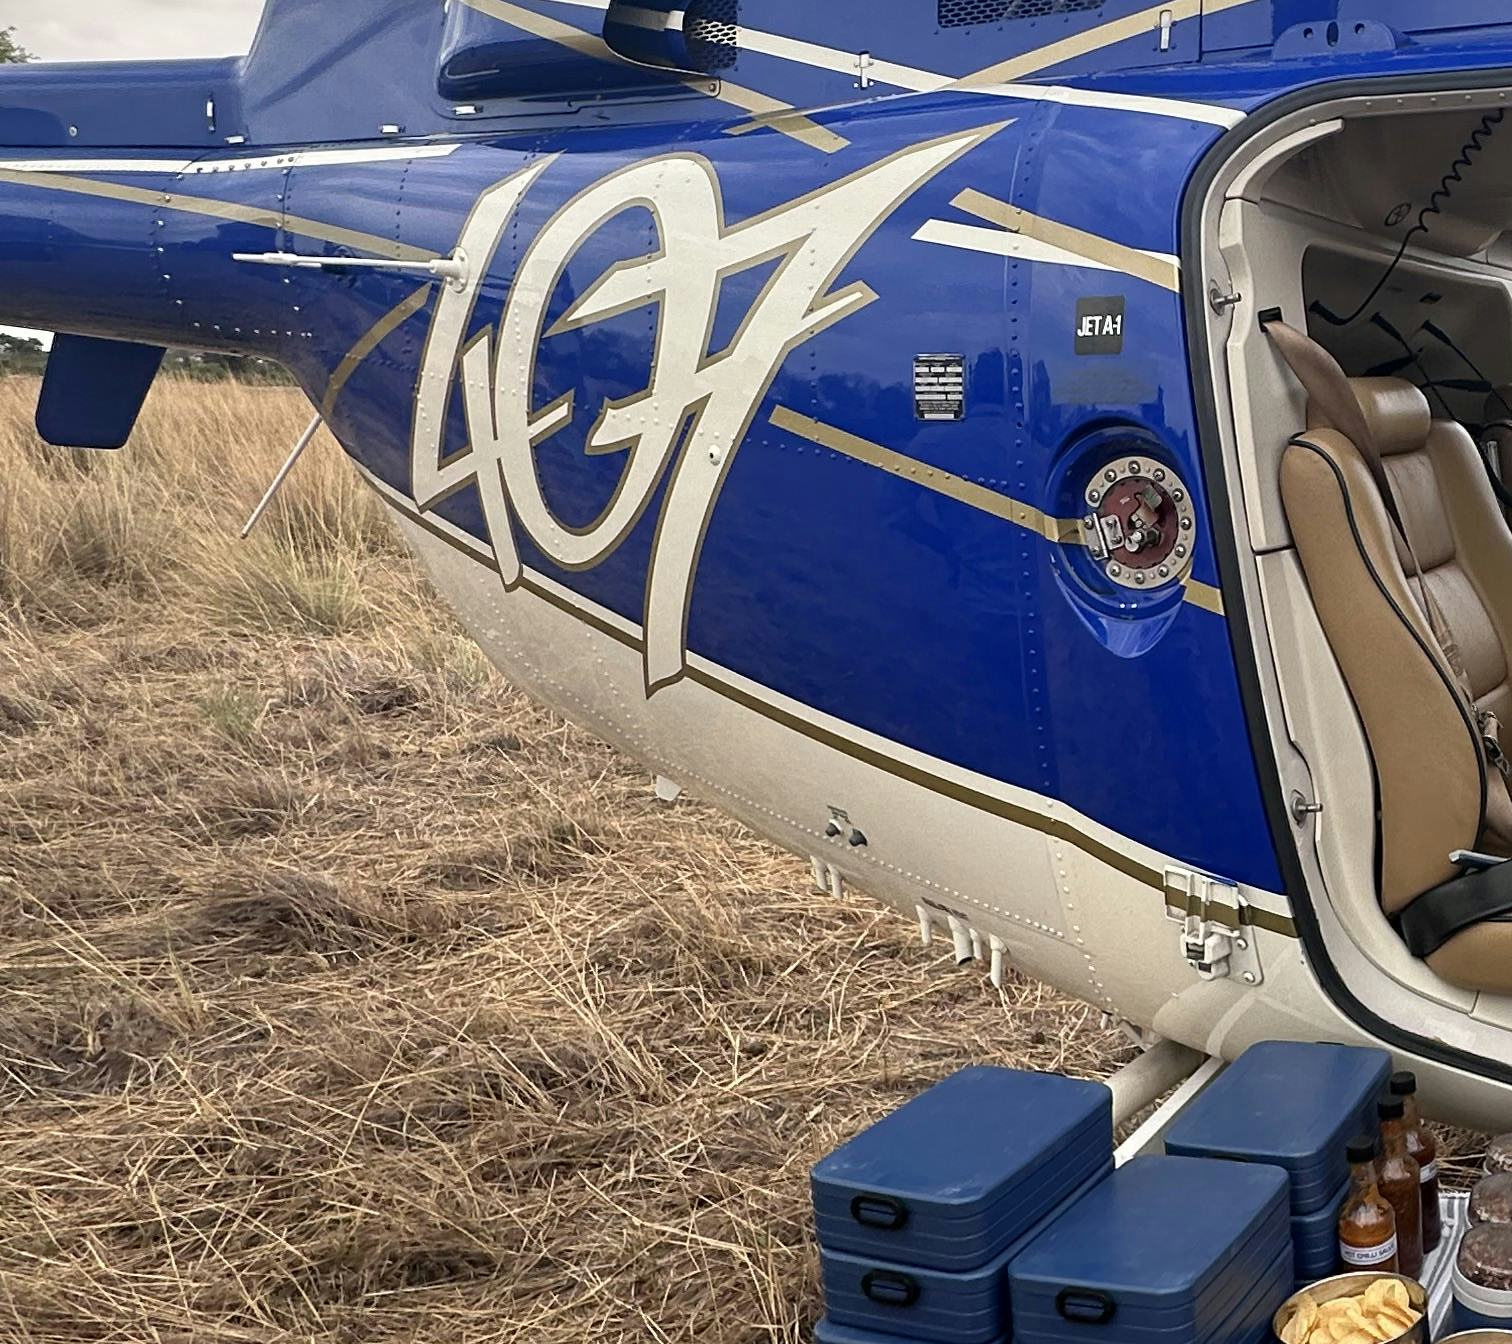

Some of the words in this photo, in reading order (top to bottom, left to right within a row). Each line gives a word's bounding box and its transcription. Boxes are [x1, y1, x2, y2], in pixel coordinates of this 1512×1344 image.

[411, 118, 1018, 699] 407
[1077, 315, 1103, 336] JET
[1102, 314, 1121, 335] A-1
